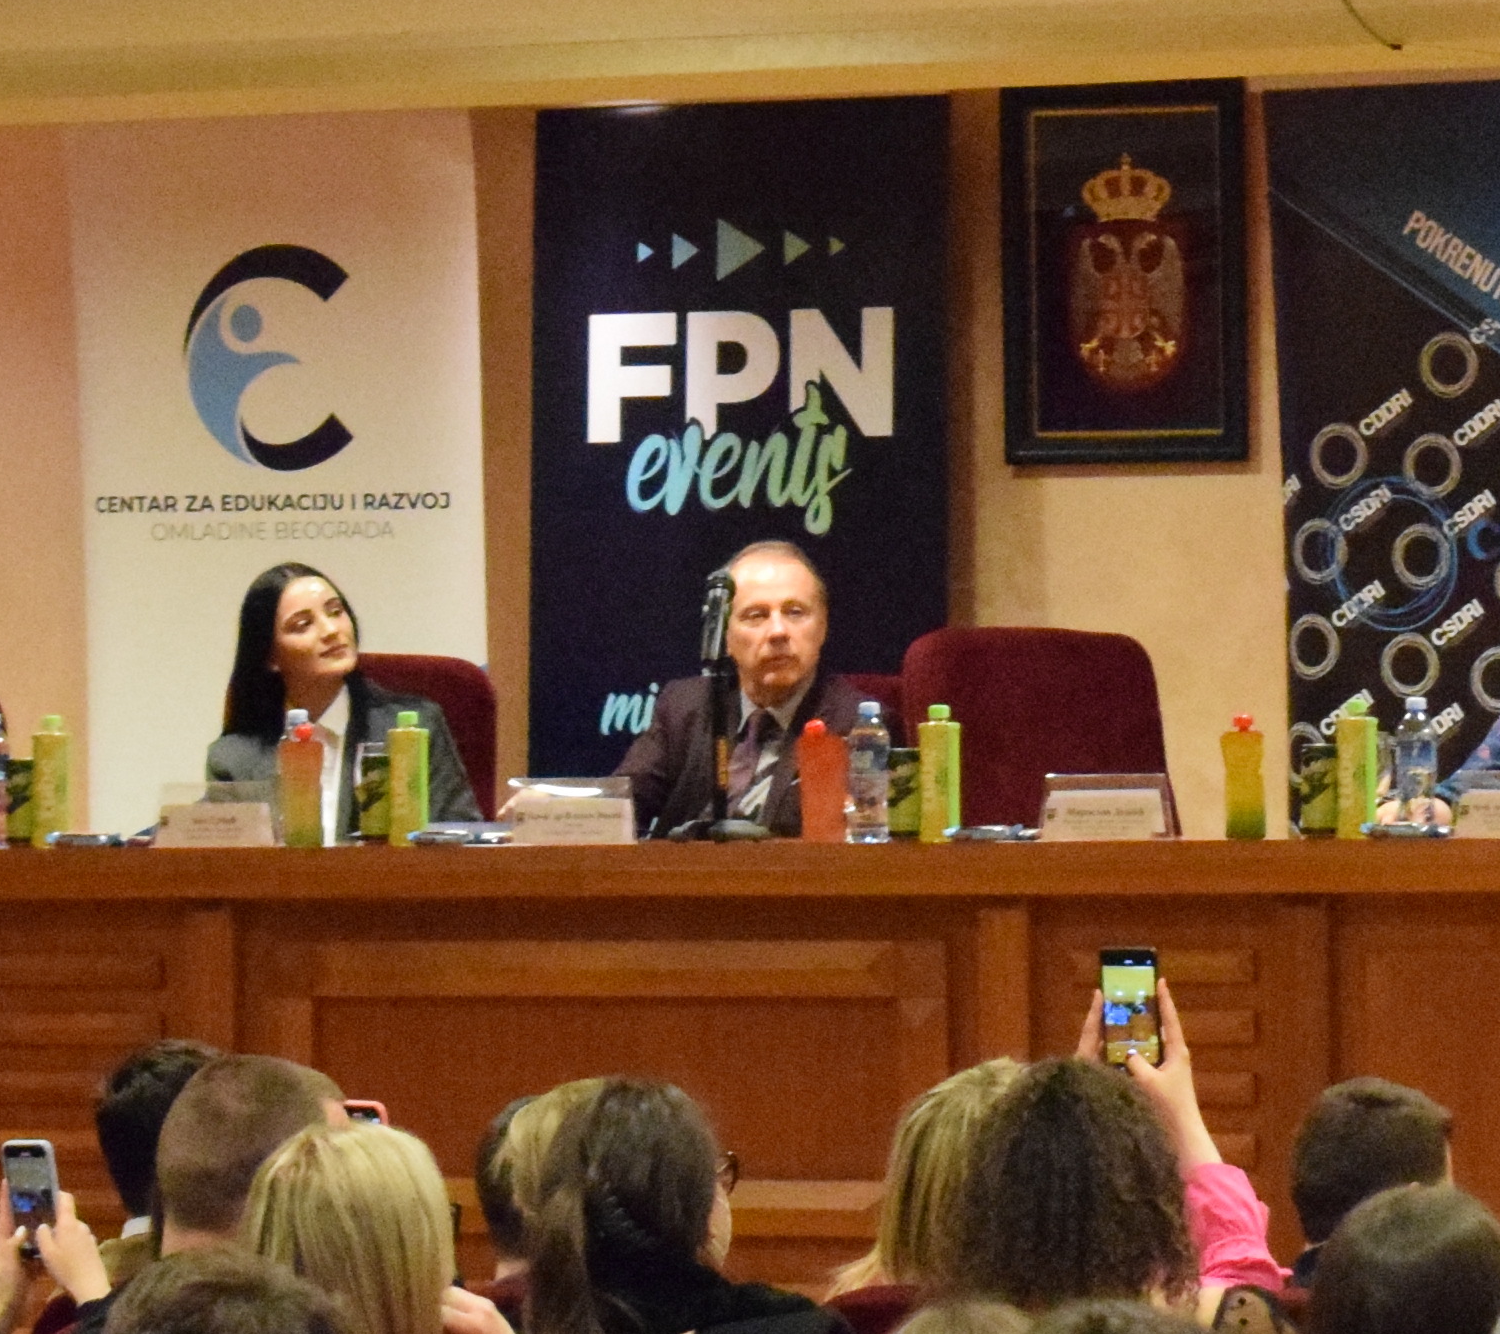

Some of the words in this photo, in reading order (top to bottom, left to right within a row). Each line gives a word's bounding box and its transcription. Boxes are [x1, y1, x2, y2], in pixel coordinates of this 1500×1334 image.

[587, 307, 894, 443] FPN
[1359, 388, 1413, 436] CDDRI
[625, 382, 853, 535] events
[95, 495, 177, 513] CENTAR
[185, 495, 215, 512] ZA
[220, 493, 344, 511] EDUKACIJU
[364, 492, 451, 510] RAZVOJ
[150, 521, 267, 542] OMLADINE
[275, 520, 395, 540] BEOGRADA
[1430, 598, 1485, 646] CSDRI
[1430, 702, 1465, 735] DRI
